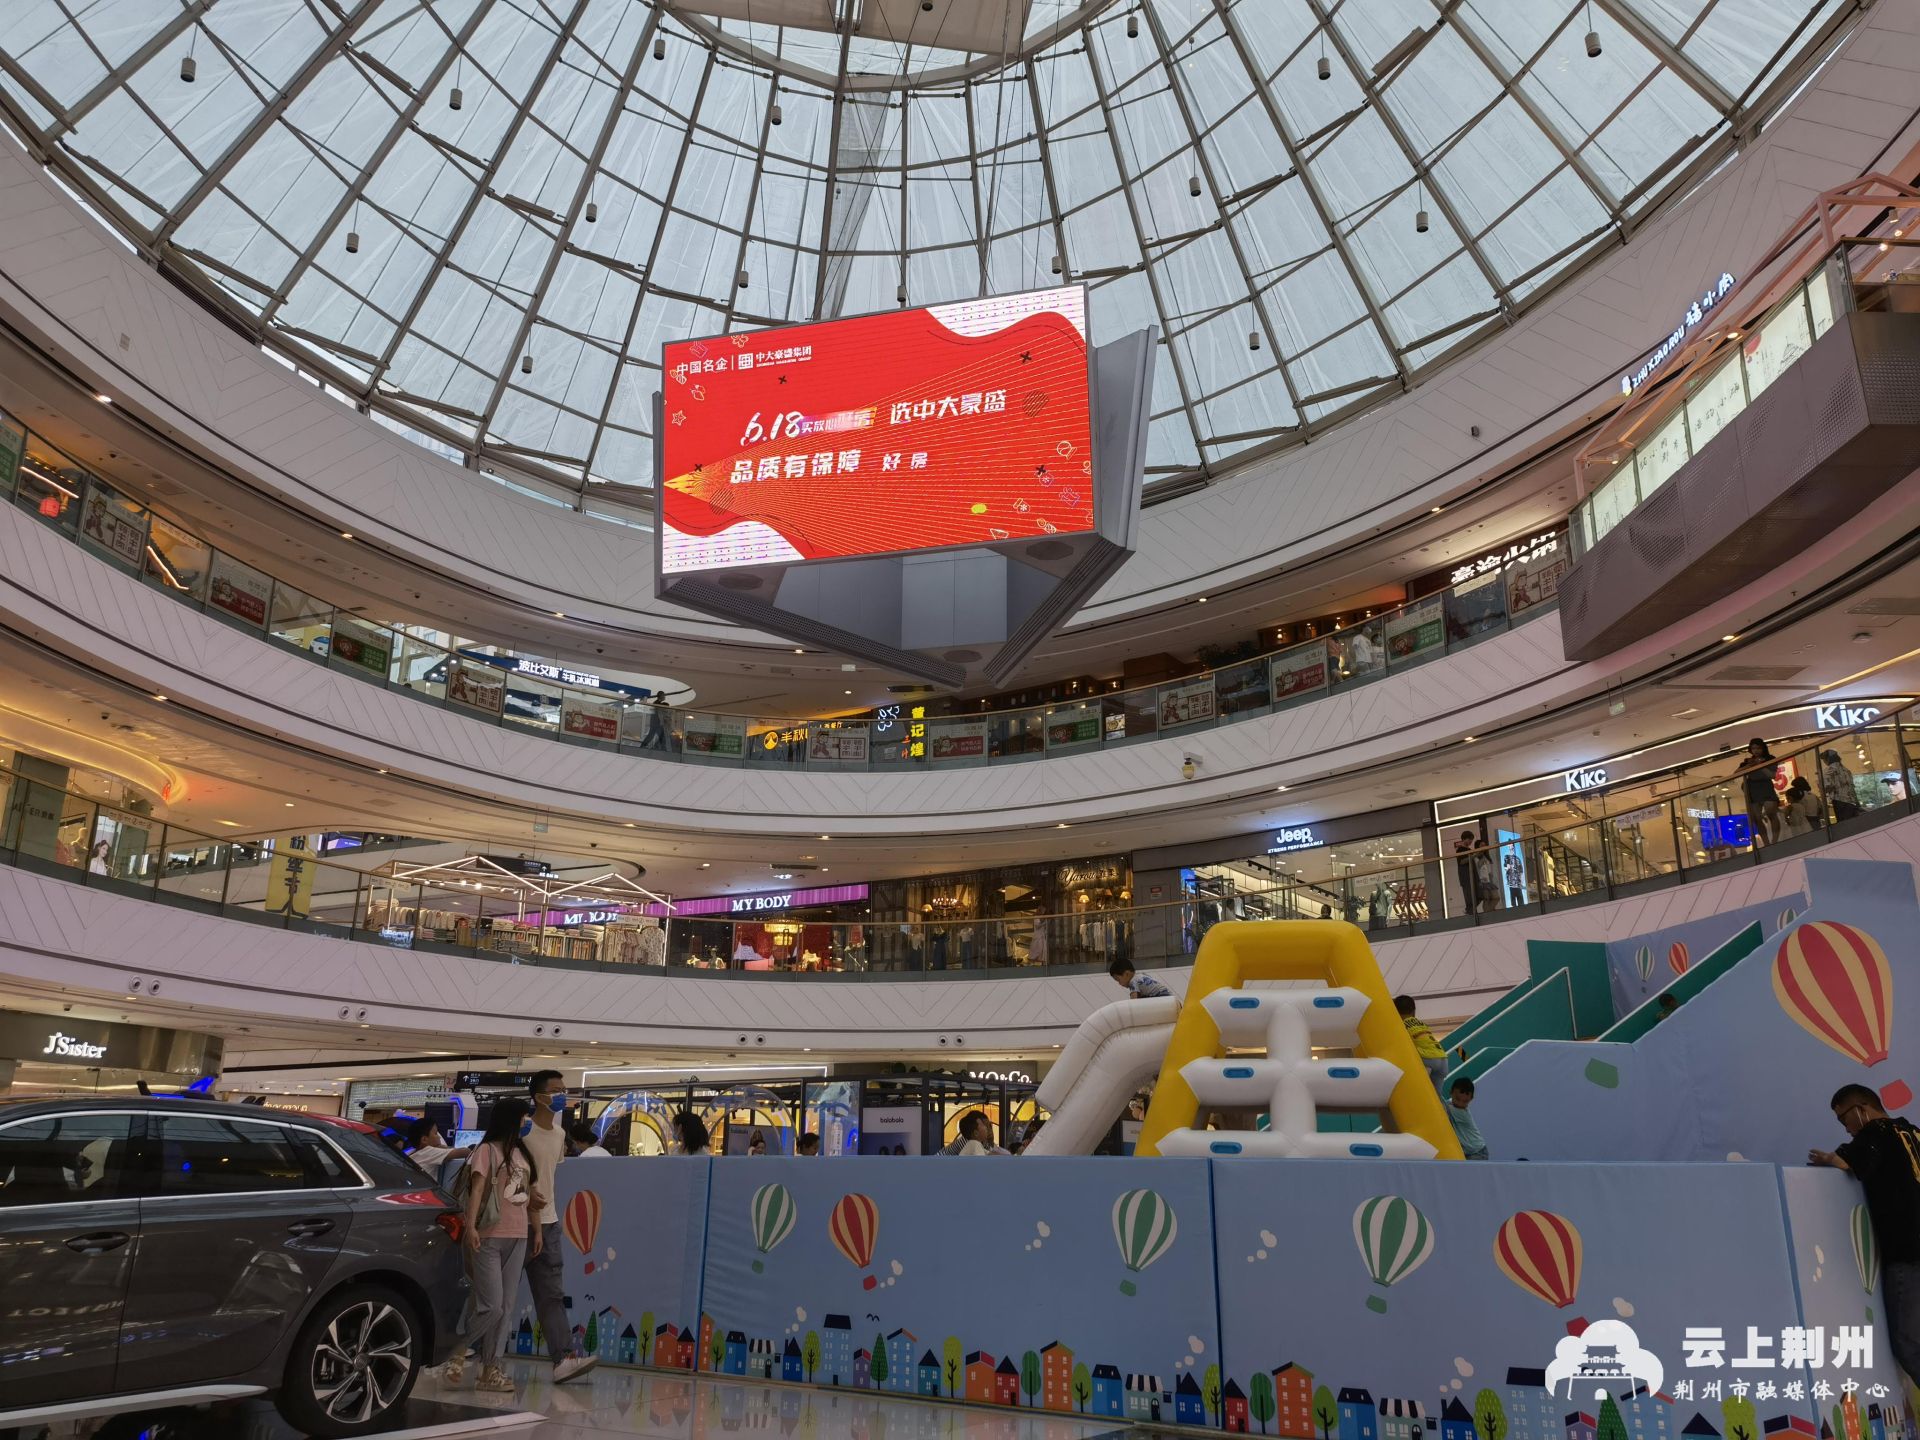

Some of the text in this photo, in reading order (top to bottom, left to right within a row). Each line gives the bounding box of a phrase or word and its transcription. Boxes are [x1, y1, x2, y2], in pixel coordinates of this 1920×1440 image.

[676, 357, 728, 376] 中国名企
[740, 411, 804, 446] 6.18
[890, 389, 1007, 425] 选中大豪盛
[730, 449, 862, 484] 品质有保障
[1276, 828, 1313, 844] Jeep
[732, 895, 792, 911] MY BODY
[43, 1031, 107, 1059] J'Sister
